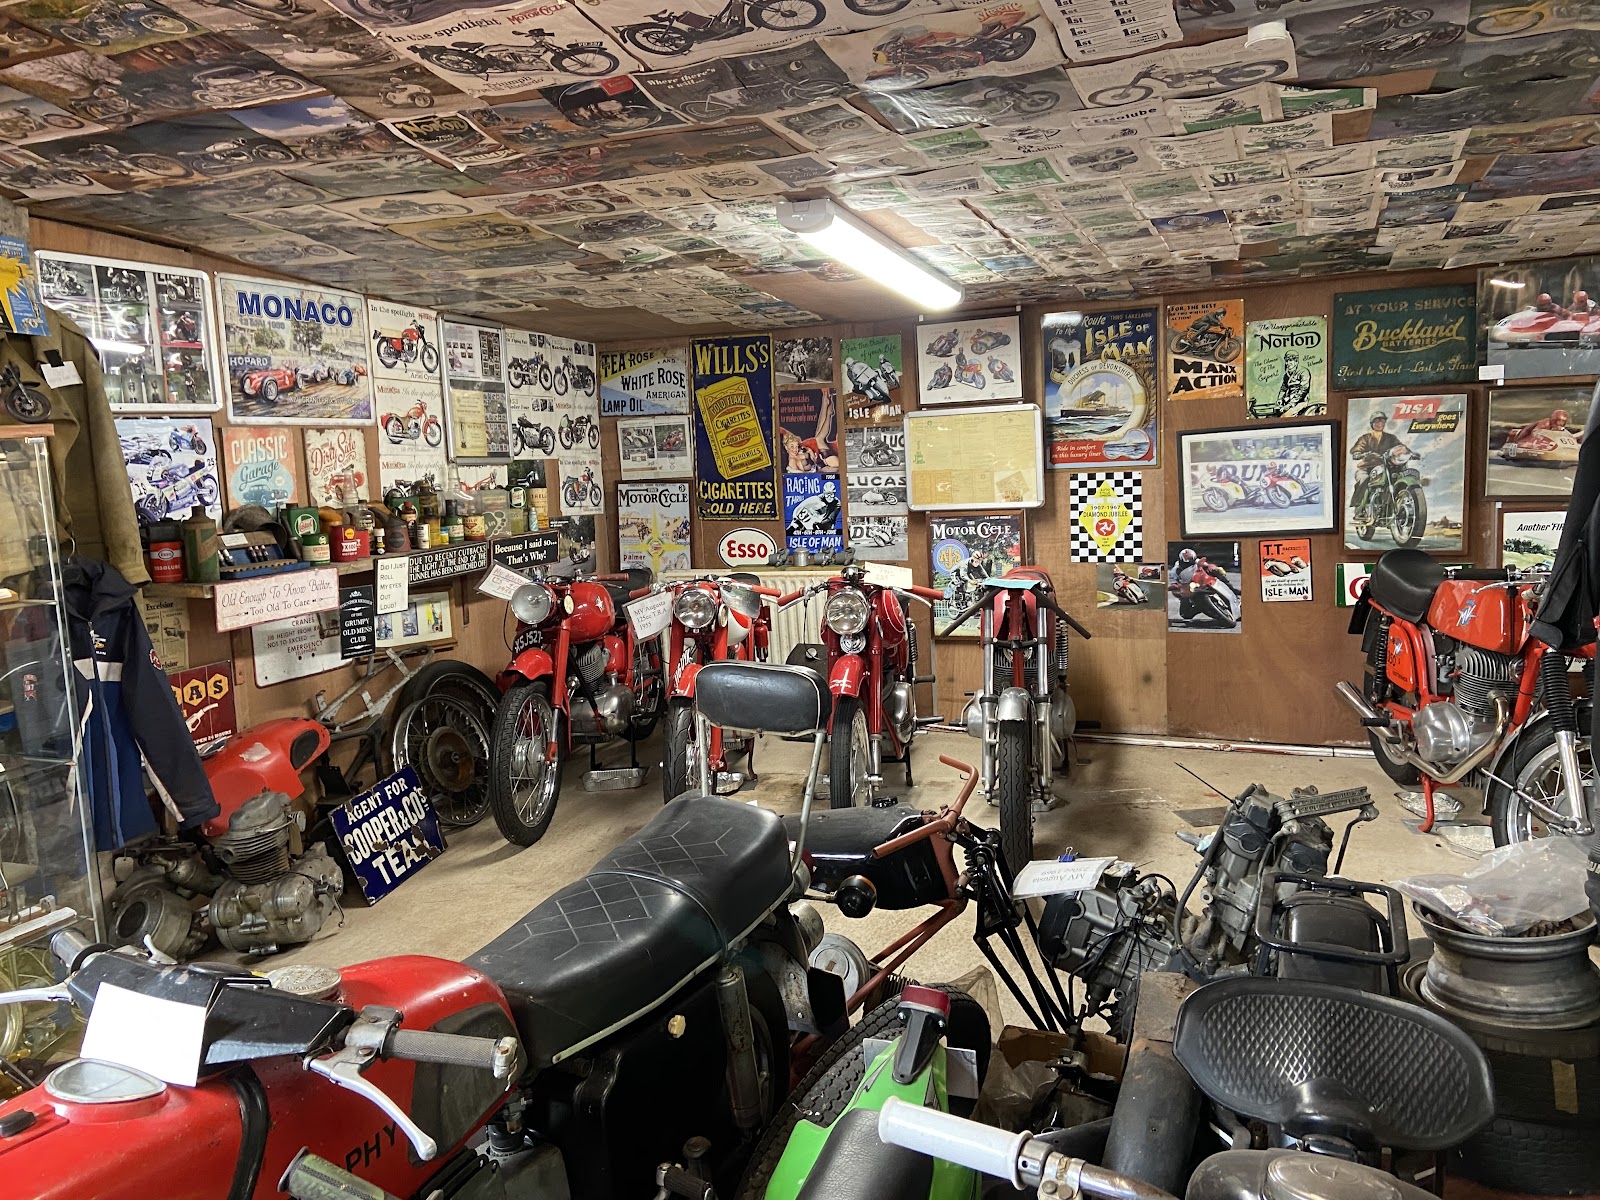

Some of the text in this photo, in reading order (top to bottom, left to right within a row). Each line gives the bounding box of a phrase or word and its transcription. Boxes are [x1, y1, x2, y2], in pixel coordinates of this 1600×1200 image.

[647, 77, 679, 89] Where
[395, 118, 469, 138] Norton
[237, 290, 354, 328] MONACO
[391, 308, 415, 319] spotlight
[1170, 304, 1185, 312] FOR
[1344, 296, 1476, 316] AT YOUR SERVICE
[1082, 314, 1107, 328] Route
[1085, 320, 1150, 358] ISLE OF
[1254, 330, 1322, 352] Norton
[1352, 315, 1467, 352] Buckland
[1100, 334, 1154, 363] MAN
[1382, 337, 1437, 348] BATTERIES
[602, 352, 654, 378] TEA ROSE
[1173, 358, 1237, 374] MANX
[1339, 365, 1364, 377] First
[1366, 365, 1375, 376] to
[1377, 362, 1401, 375] Start
[1436, 364, 1445, 372] to
[621, 367, 686, 391] WHITE ROSE
[1067, 362, 1134, 385] DUCHESS DEVONSHIRE
[1172, 374, 1238, 396] ACTION
[645, 391, 686, 400] AMERICAN
[603, 399, 626, 413] LAMP
[629, 397, 644, 412] OIL
[849, 404, 901, 420] ISLE MAN
[1398, 402, 1434, 415] BSA
[715, 410, 751, 430] CIGARETTES
[1411, 420, 1456, 432] Everywhere
[1438, 413, 1457, 424] goes
[231, 434, 289, 465] CLASSIC
[312, 439, 337, 476] Dirty
[336, 431, 356, 462] Side
[1076, 444, 1096, 452] comfort
[206, 457, 216, 466] 25
[1070, 451, 1088, 461] luxury
[239, 461, 280, 492] Garage
[1217, 462, 1311, 482] DUNOP
[786, 476, 821, 494] RACING
[848, 475, 906, 487] LUCAS
[618, 488, 689, 508] MOTOR CYCLE
[699, 481, 774, 500] CIGARETTES
[739, 502, 775, 515] HERE.
[930, 522, 1012, 541] MOTOR CYCLE
[1517, 523, 1551, 532] Another
[495, 543, 522, 555] Because
[529, 539, 542, 549] said
[544, 538, 557, 547] so...
[789, 536, 841, 549] ISLE OF MAN
[1263, 543, 1284, 555] T.T.
[410, 545, 487, 566] DUE TO RECENT CUTBACKS
[410, 564, 420, 573] THE
[422, 562, 437, 571] LIGHT
[447, 558, 456, 566] THE
[458, 556, 468, 564] END
[478, 552, 486, 560] THE
[507, 550, 547, 565] That's Why!
[624, 554, 646, 562] palmer
[410, 560, 486, 582] TUNNEL HAS BEEN SWITCHED OFF
[222, 594, 237, 608] Old
[239, 588, 266, 607] Enough
[270, 585, 280, 599] To
[283, 582, 307, 596] Know
[1265, 586, 1309, 597] ISLE MAN
[146, 601, 173, 610] Excelsior
[250, 598, 311, 616] Too Old To Care
[634, 601, 666, 616] MV Augusta
[292, 616, 315, 627] CRANES
[344, 618, 370, 628] GRUMPY
[276, 627, 311, 640] HEIGHT FROM
[342, 626, 372, 637] OLD MENS
[267, 641, 279, 649] NOT
[288, 635, 308, 645] EXCEED
[287, 640, 323, 653] EMERGENCY
[350, 635, 367, 644] CLUB
[214, 729, 232, 739] HOURS
[345, 777, 408, 825] AGENT FOR
[371, 838, 421, 885] TEA
[1032, 875, 1066, 884] Augusta
